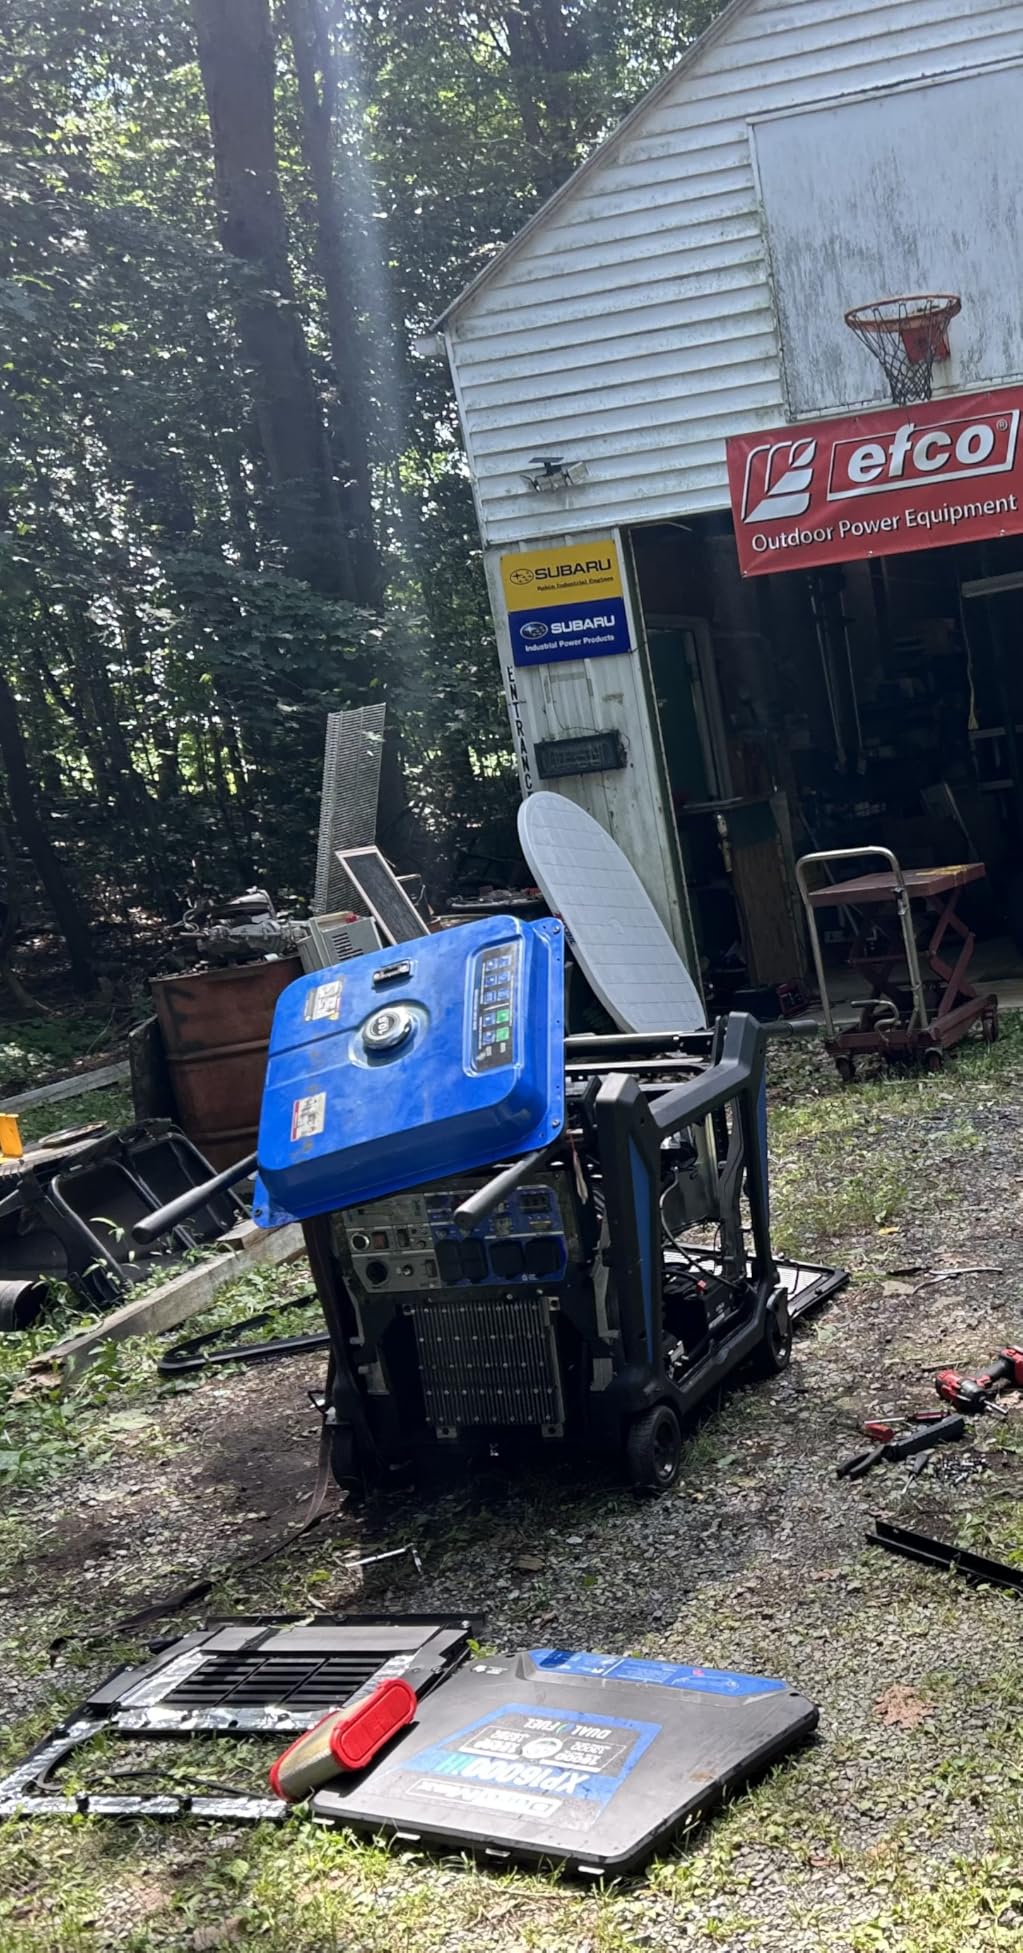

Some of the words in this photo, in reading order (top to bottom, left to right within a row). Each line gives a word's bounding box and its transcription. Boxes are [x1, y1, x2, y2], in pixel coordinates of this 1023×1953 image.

[847, 423, 995, 484] efco
[752, 527, 834, 552] Outdoor
[839, 515, 901, 538] Power
[905, 494, 1017, 530] Equipment
[534, 558, 612, 580] SUBARU
[551, 615, 616, 634] SUBARU
[525, 640, 558, 652] Industrial
[559, 638, 582, 649] Power
[583, 634, 615, 645] Products
[507, 666, 534, 796] ENTRANC
[523, 1717, 560, 1733] FUEL
[571, 1725, 613, 1740] DUAL
